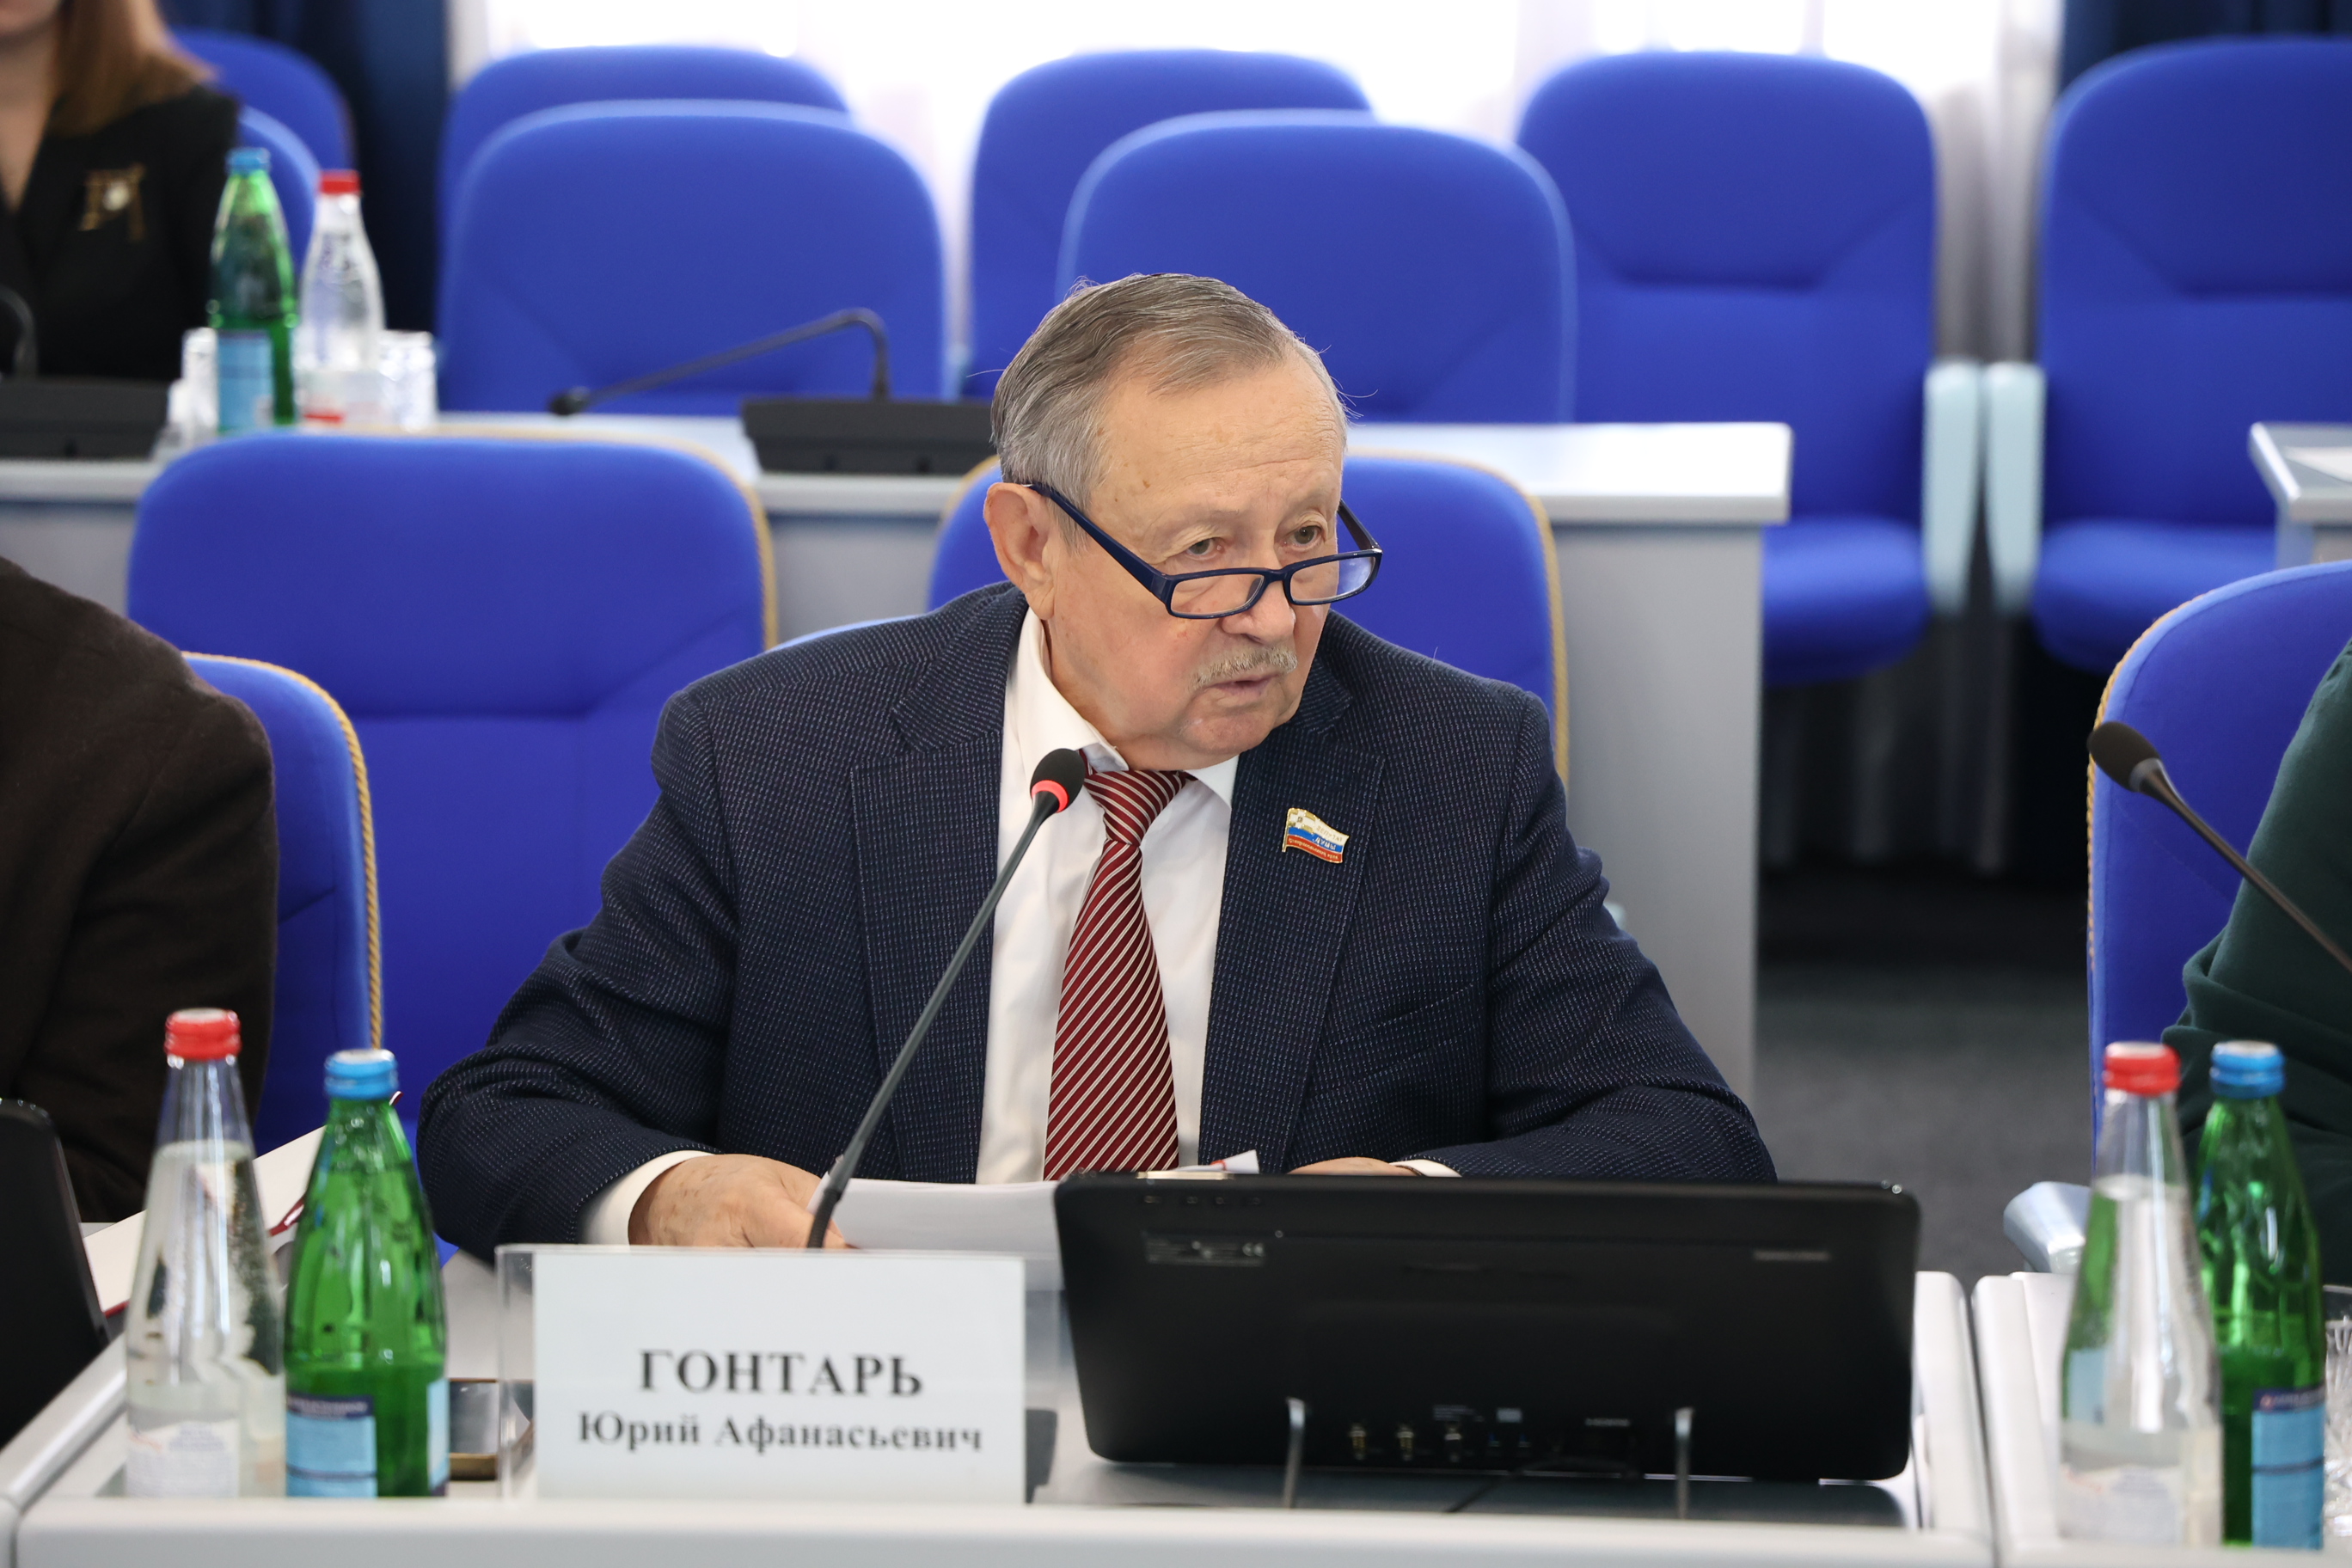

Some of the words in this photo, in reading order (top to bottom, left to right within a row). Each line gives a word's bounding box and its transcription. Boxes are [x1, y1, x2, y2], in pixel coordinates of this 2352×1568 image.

[640, 1350, 923, 1396] ГОНТАРЬ
[579, 1412, 701, 1453] Юрий
[717, 1417, 982, 1455] Афанасьевич
